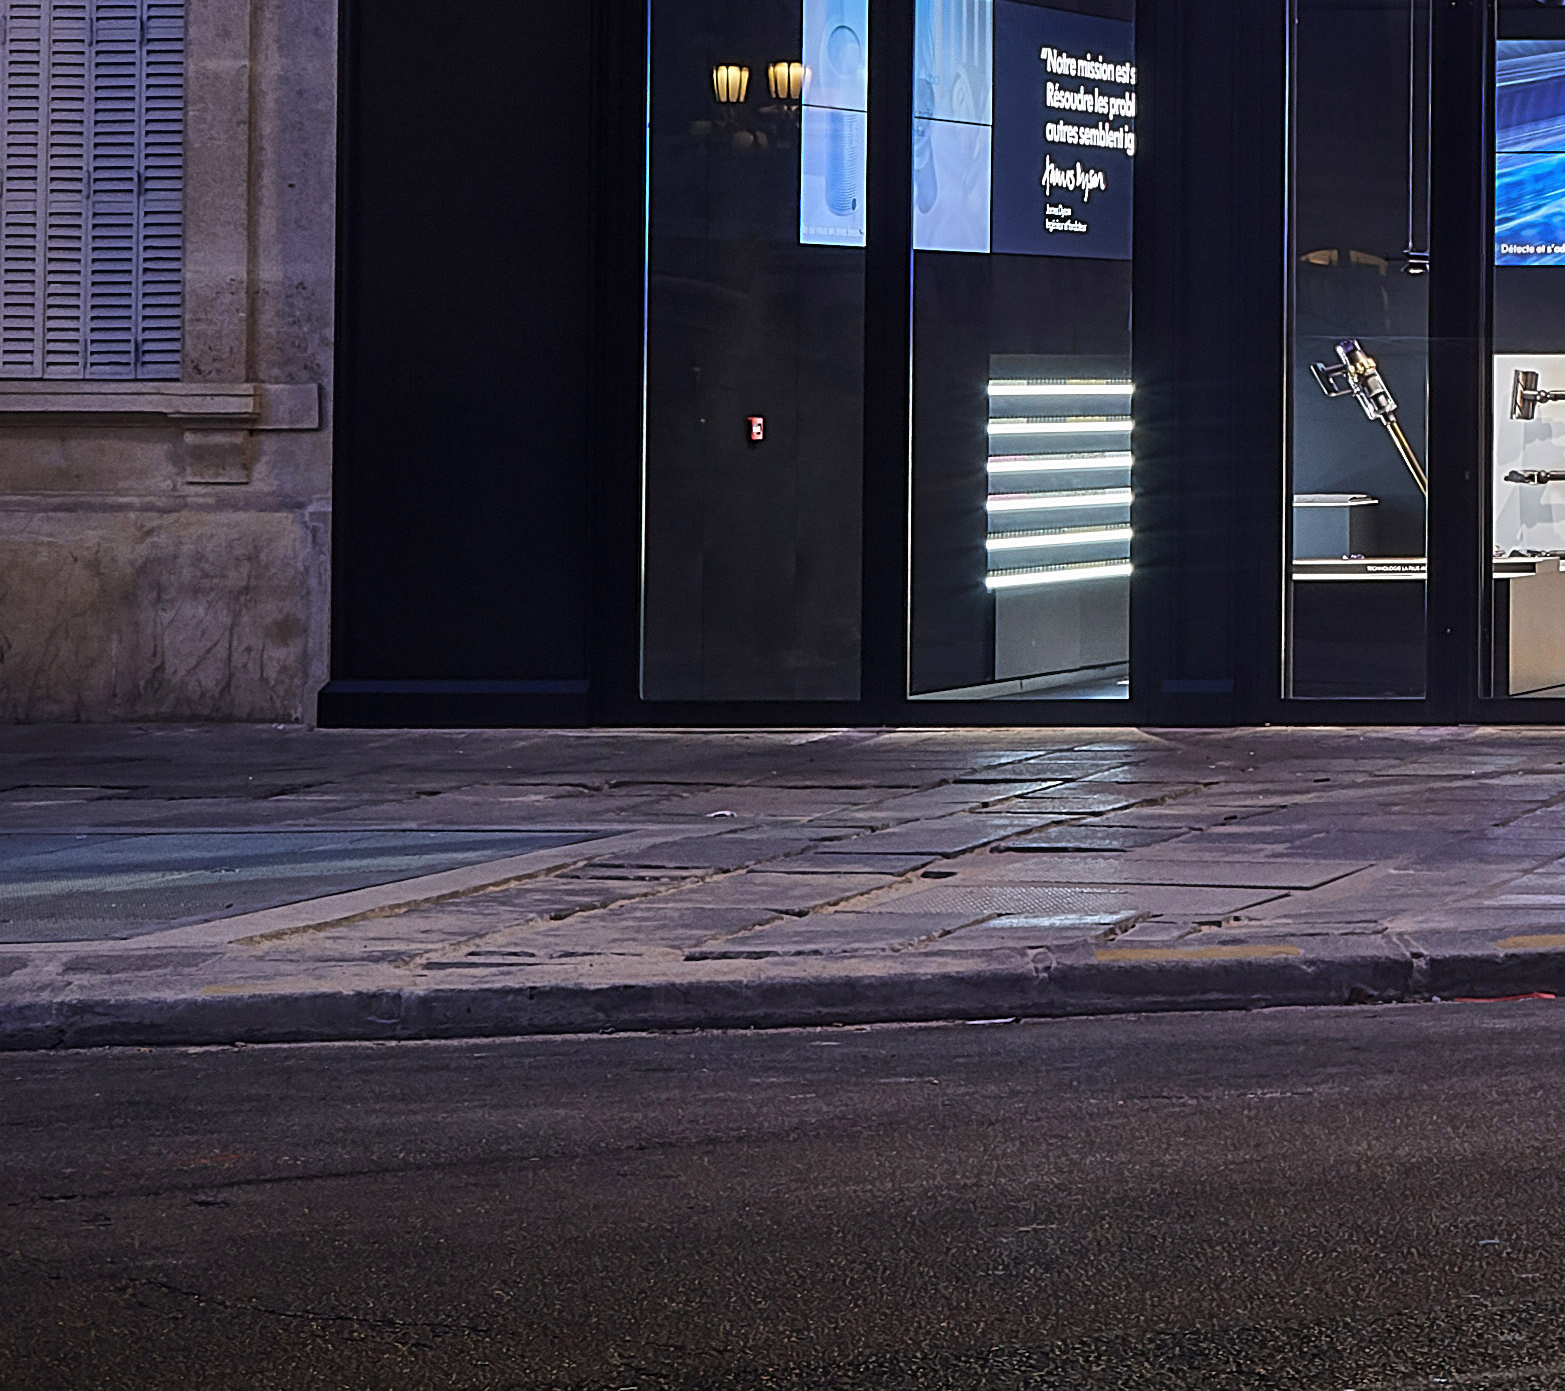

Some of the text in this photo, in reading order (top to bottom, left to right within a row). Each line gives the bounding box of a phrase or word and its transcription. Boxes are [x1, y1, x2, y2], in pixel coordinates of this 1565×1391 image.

[1077, 53, 1115, 81] mission
[1046, 82, 1094, 113] Résoudre
[1094, 88, 1109, 114] les
[1046, 120, 1078, 144] autres
[1079, 122, 1124, 149] semblent
[1501, 243, 1535, 254] Détecte
[1536, 245, 1545, 253] et
